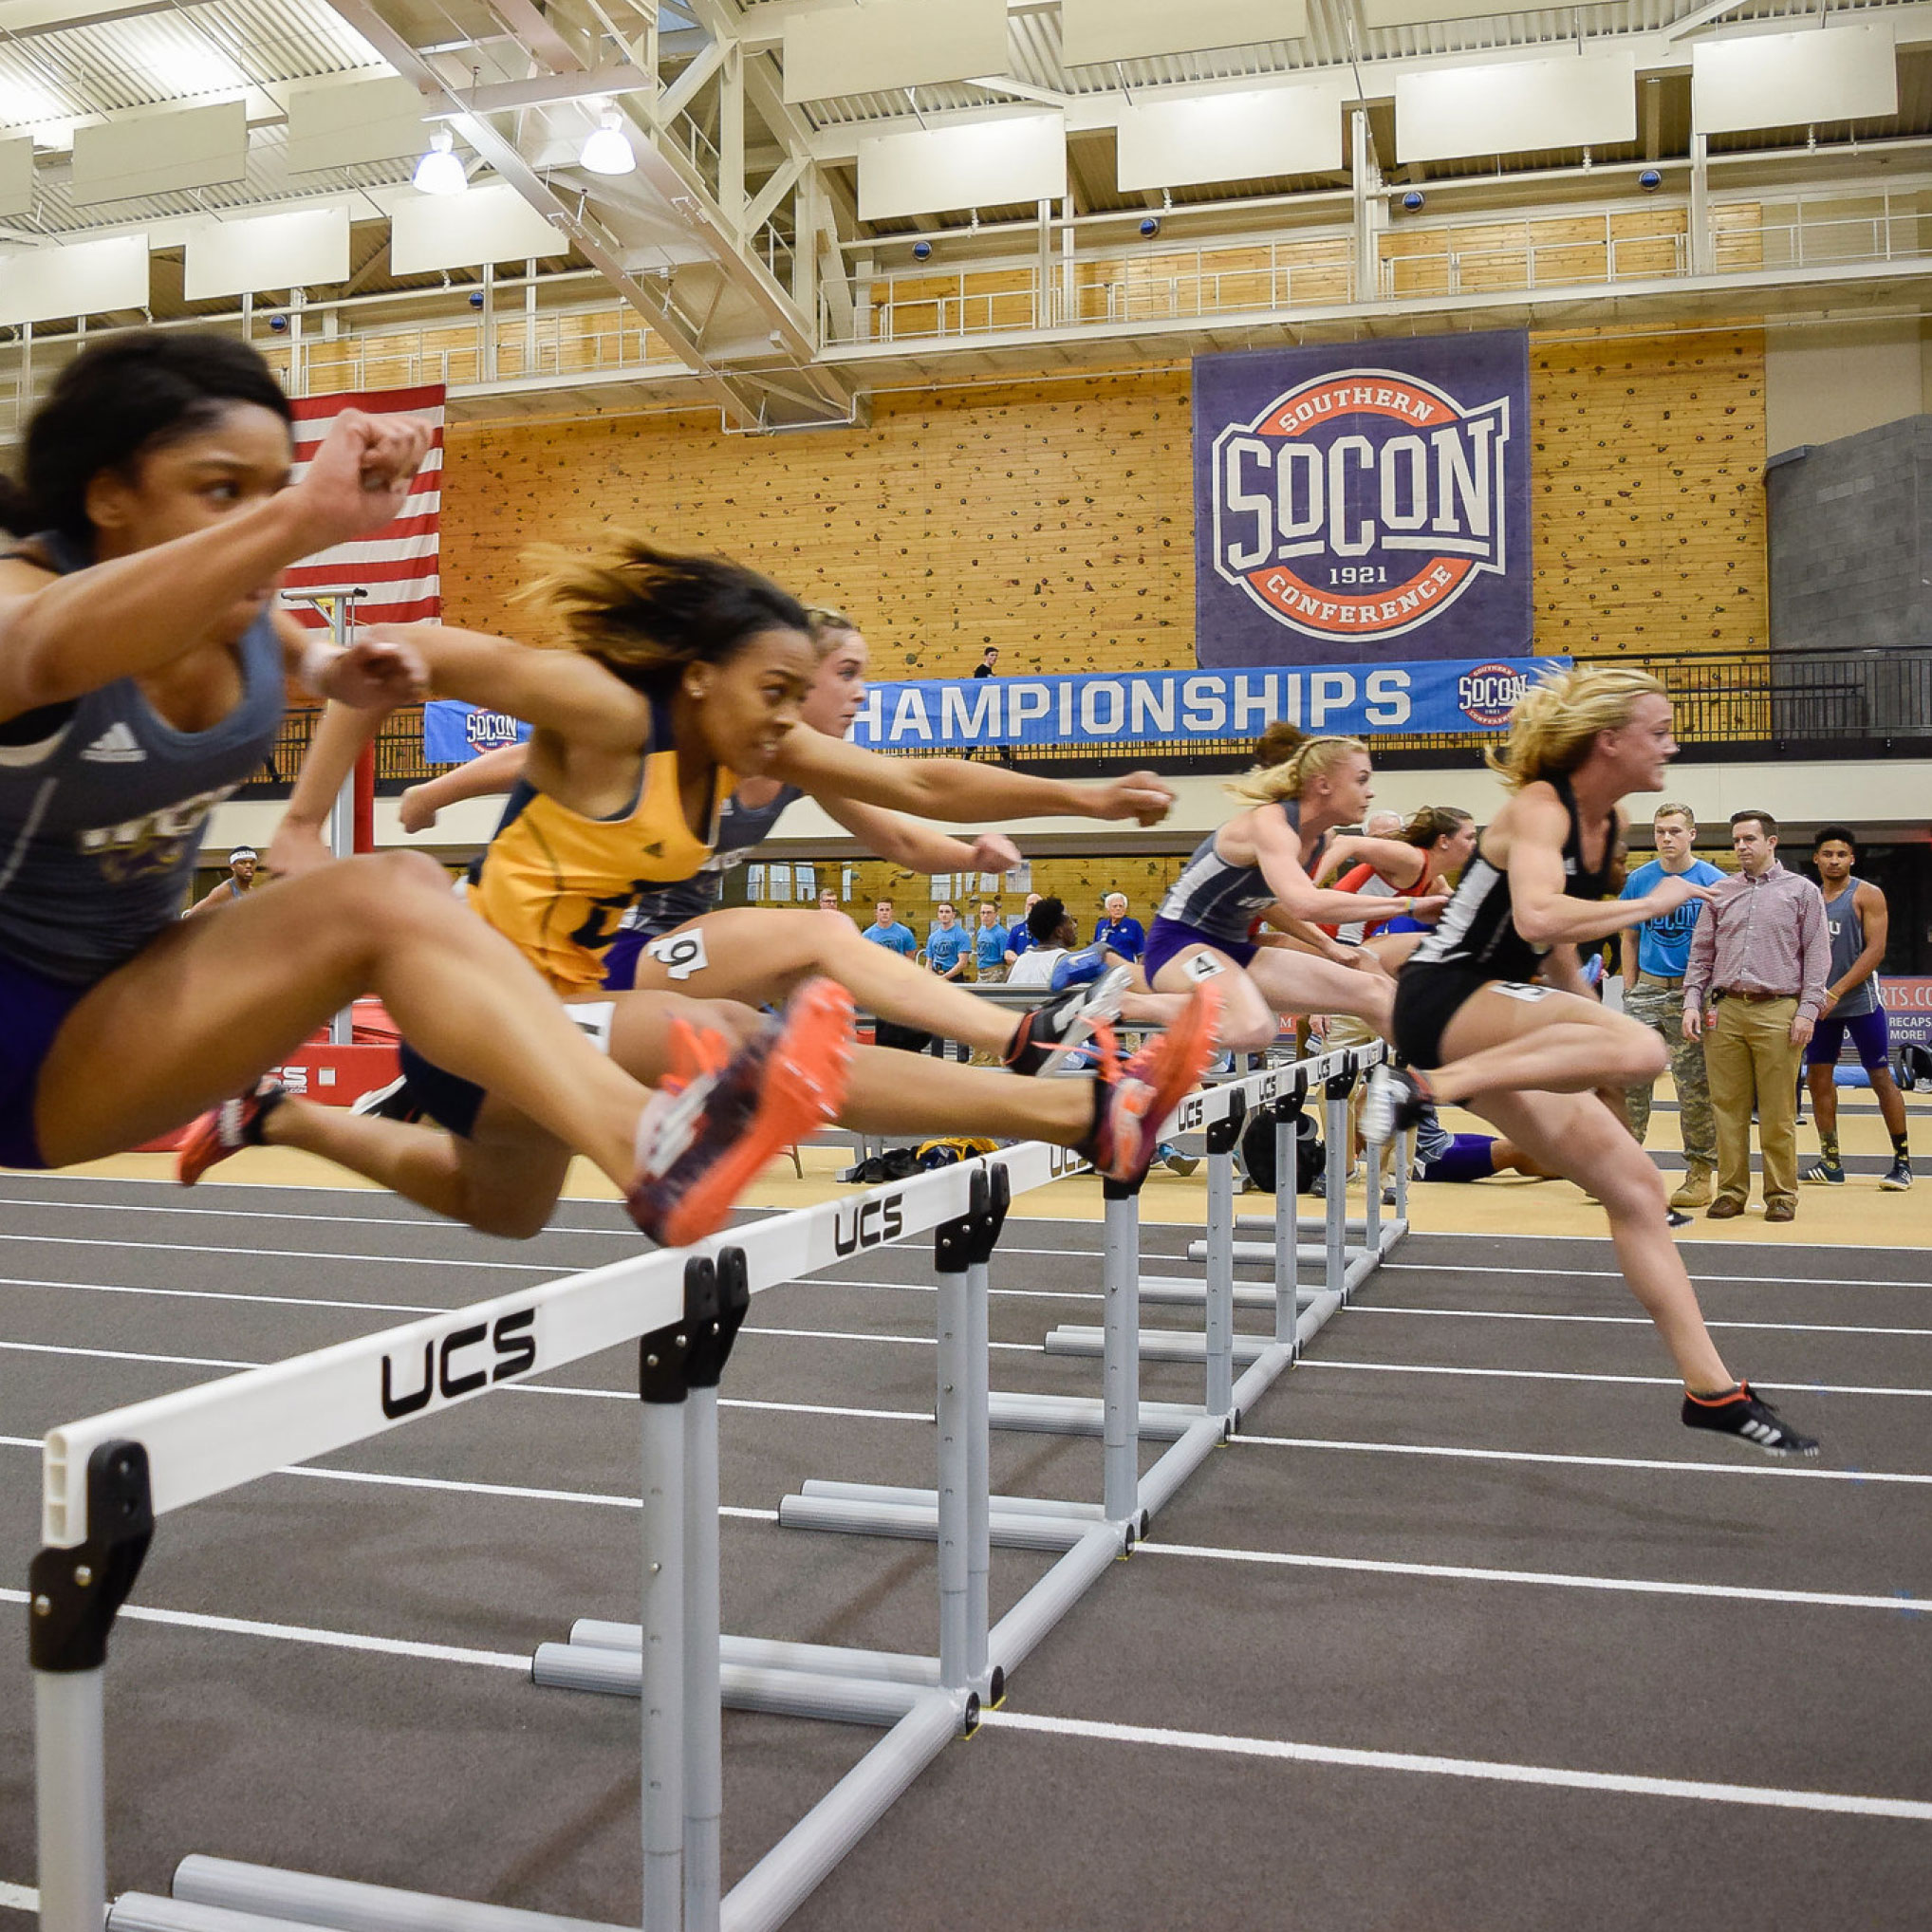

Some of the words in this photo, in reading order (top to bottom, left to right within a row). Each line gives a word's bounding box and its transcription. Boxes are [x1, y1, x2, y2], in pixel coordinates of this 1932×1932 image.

[1277, 386, 1435, 435] SOUTHERN
[1226, 418, 1495, 570] SOCON
[1266, 565, 1453, 623] CONFERENCE
[1329, 566, 1387, 585] 1921
[846, 669, 1411, 743] HAMPIONSHIPS
[1458, 674, 1528, 710] SOCON
[466, 714, 517, 743] SOCON
[1196, 957, 1217, 975] 4
[1889, 1030, 1926, 1041] MORE!
[1177, 1098, 1203, 1132] UCS
[833, 1193, 903, 1256] UCS
[381, 1307, 537, 1421] UCS
